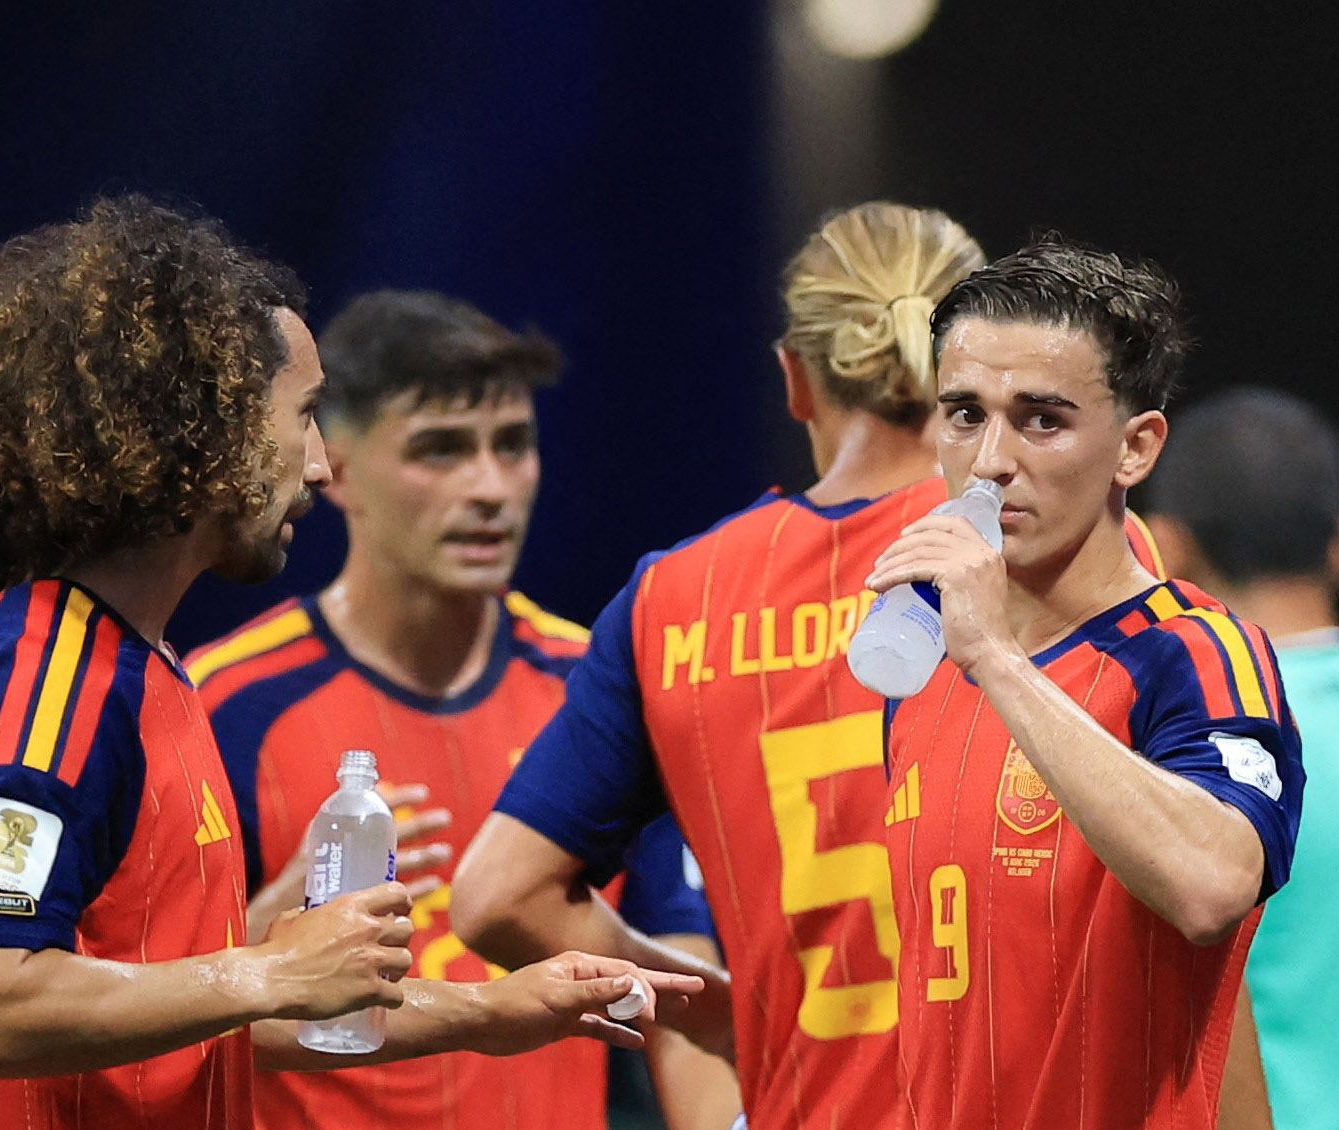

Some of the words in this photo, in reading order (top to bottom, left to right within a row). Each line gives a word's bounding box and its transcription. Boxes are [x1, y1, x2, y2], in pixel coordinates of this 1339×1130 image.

[662, 621, 715, 690] M.
[327, 842, 342, 894] water
[759, 708, 901, 1041] 5
[927, 864, 970, 1002] 9
